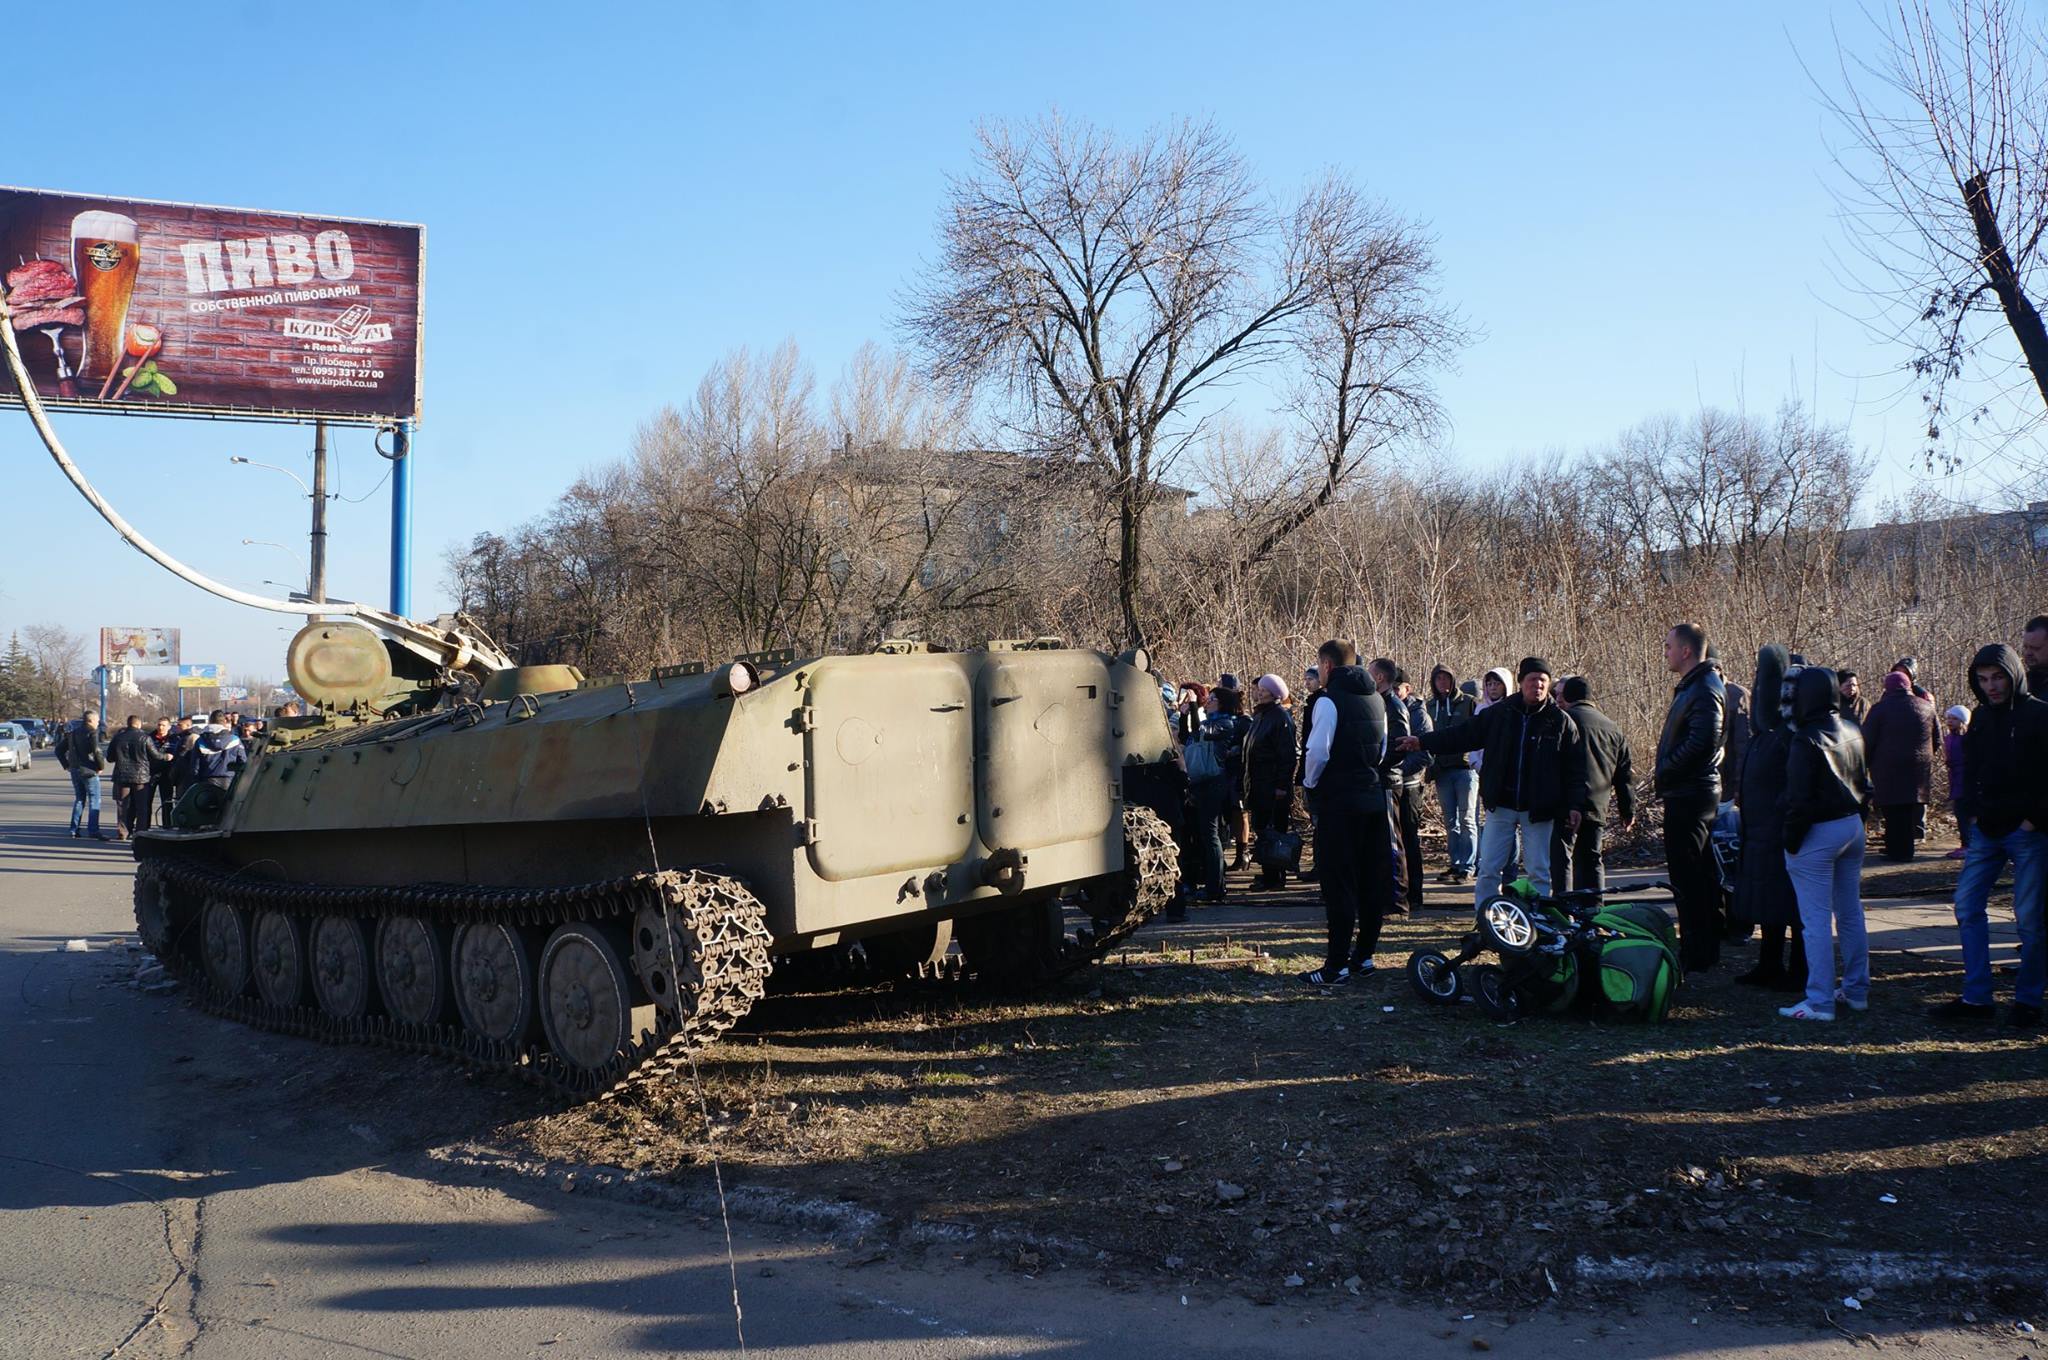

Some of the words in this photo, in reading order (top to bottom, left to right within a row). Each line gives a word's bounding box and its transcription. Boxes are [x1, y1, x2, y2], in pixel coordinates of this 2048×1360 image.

[179, 229, 355, 294] ПИВО
[190, 291, 283, 313] СОБСТВЕННОЙ
[284, 285, 361, 303] ПИВОВАРНИ
[311, 343, 338, 352] Rest
[339, 344, 365, 353] Beer
[302, 356, 319, 366] Пр.
[320, 357, 359, 368] Победы,
[361, 360, 372, 368] 13
[312, 367, 337, 376] (095)
[338, 368, 356, 377] 331
[358, 370, 370, 378] 27
[371, 370, 384, 379] 00
[296, 377, 378, 388] www.kirpich.co.ua
